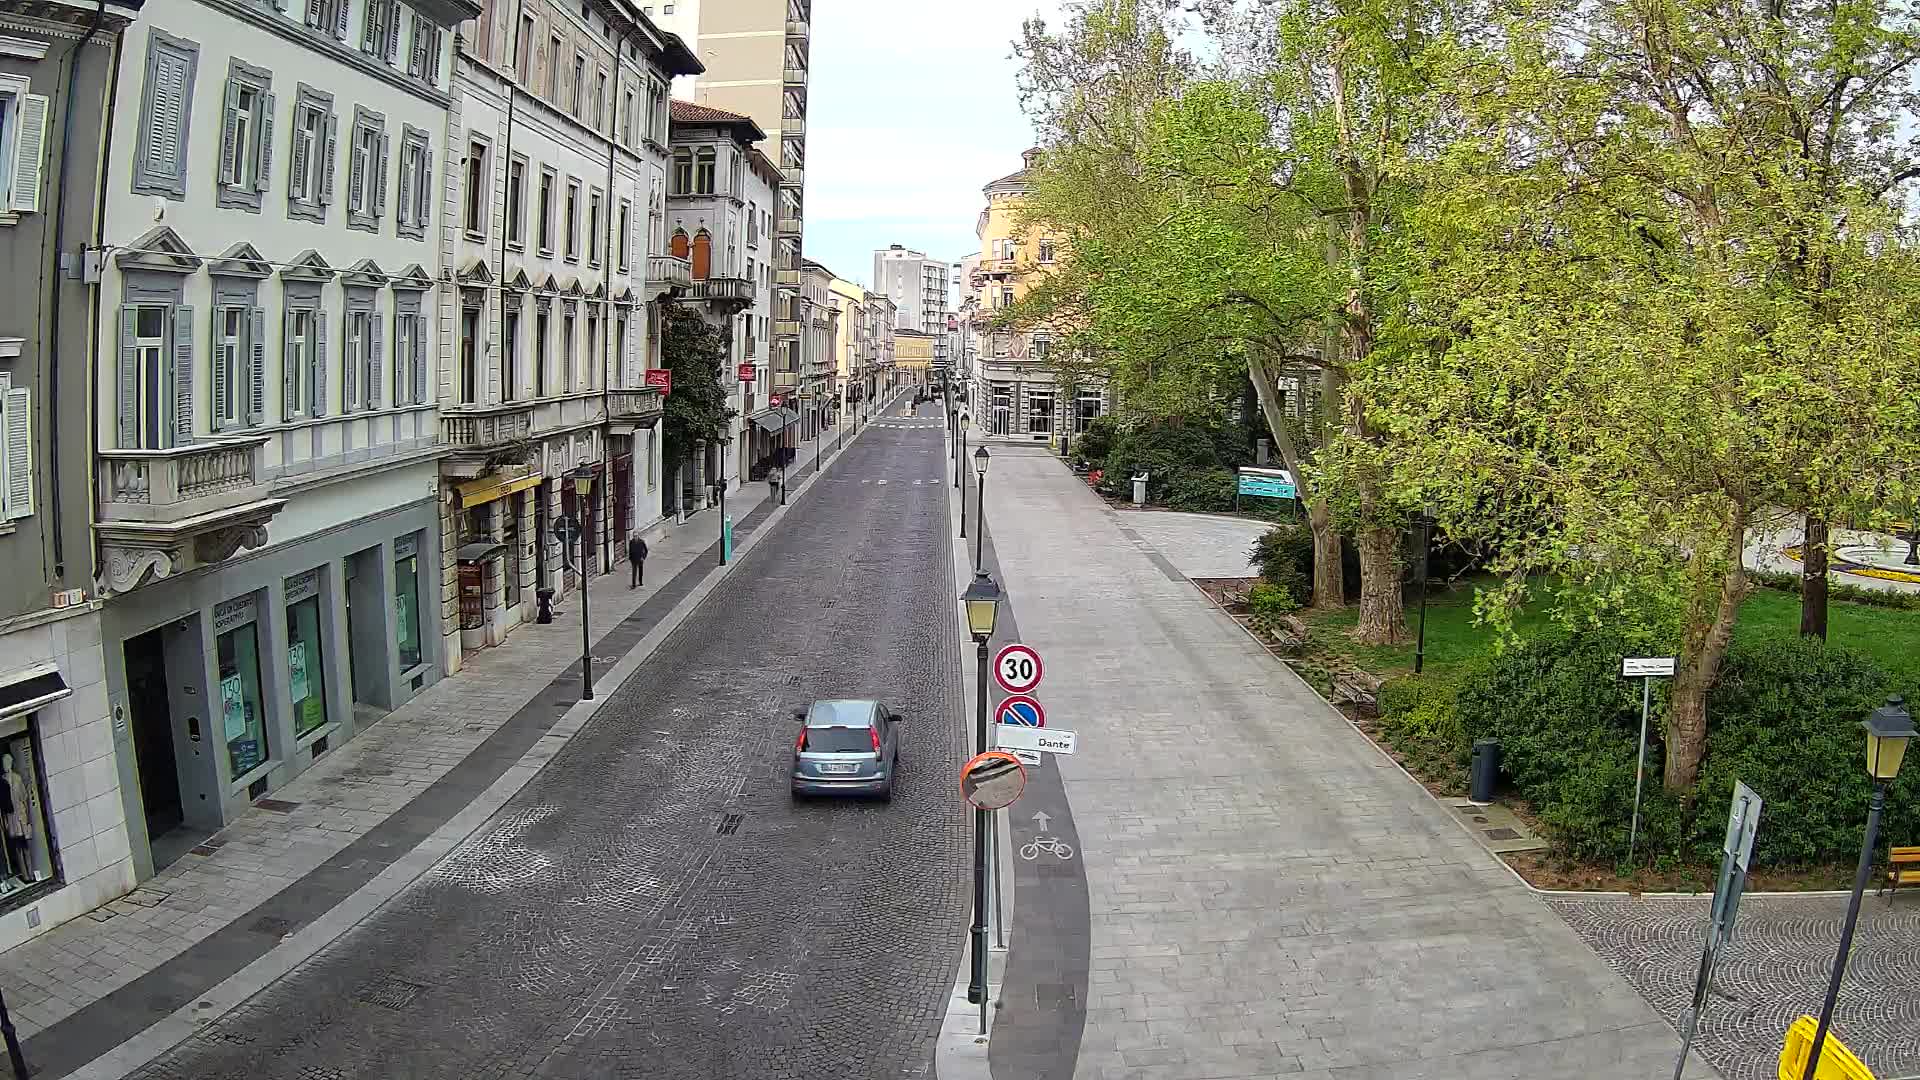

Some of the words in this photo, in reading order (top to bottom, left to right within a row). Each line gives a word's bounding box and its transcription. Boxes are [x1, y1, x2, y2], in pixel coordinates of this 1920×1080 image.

[1005, 658, 1033, 680] 30
[221, 677, 240, 700] 130
[1038, 738, 1070, 749] Dante
